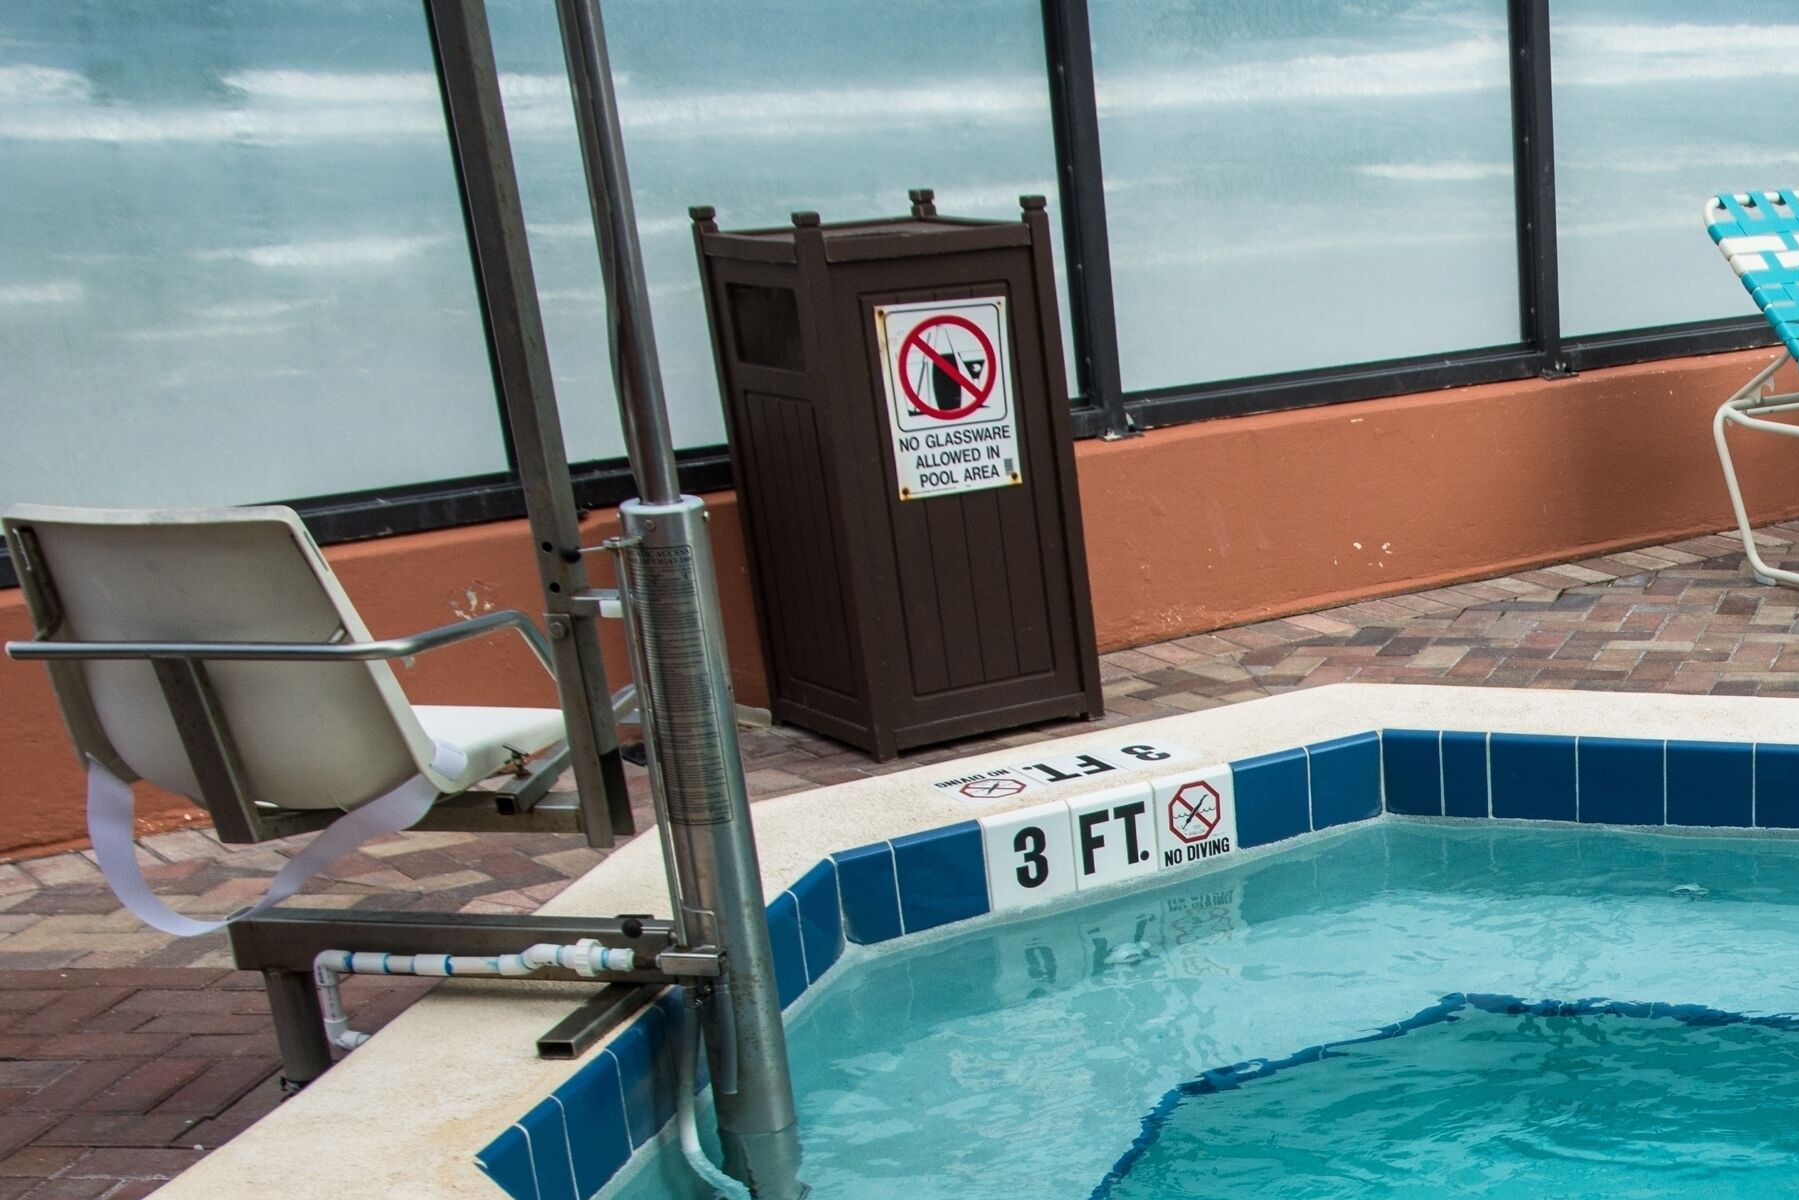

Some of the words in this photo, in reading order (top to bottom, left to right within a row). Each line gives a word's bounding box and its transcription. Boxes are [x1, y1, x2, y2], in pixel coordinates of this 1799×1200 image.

[899, 436, 920, 452] NO
[925, 425, 1011, 448] GLASSWARE
[916, 448, 981, 469] ALLOWED
[986, 445, 1000, 459] IN
[920, 470, 959, 488] POOL
[964, 464, 1000, 481] AREA
[1120, 745, 1172, 761] 3
[987, 769, 1011, 778] NO
[1022, 755, 1117, 783] FT.
[934, 774, 986, 789] DIVING
[1013, 826, 1049, 888] 3
[1079, 801, 1150, 875] FT.
[1164, 848, 1182, 867] NO
[1187, 837, 1230, 861] DIVING
